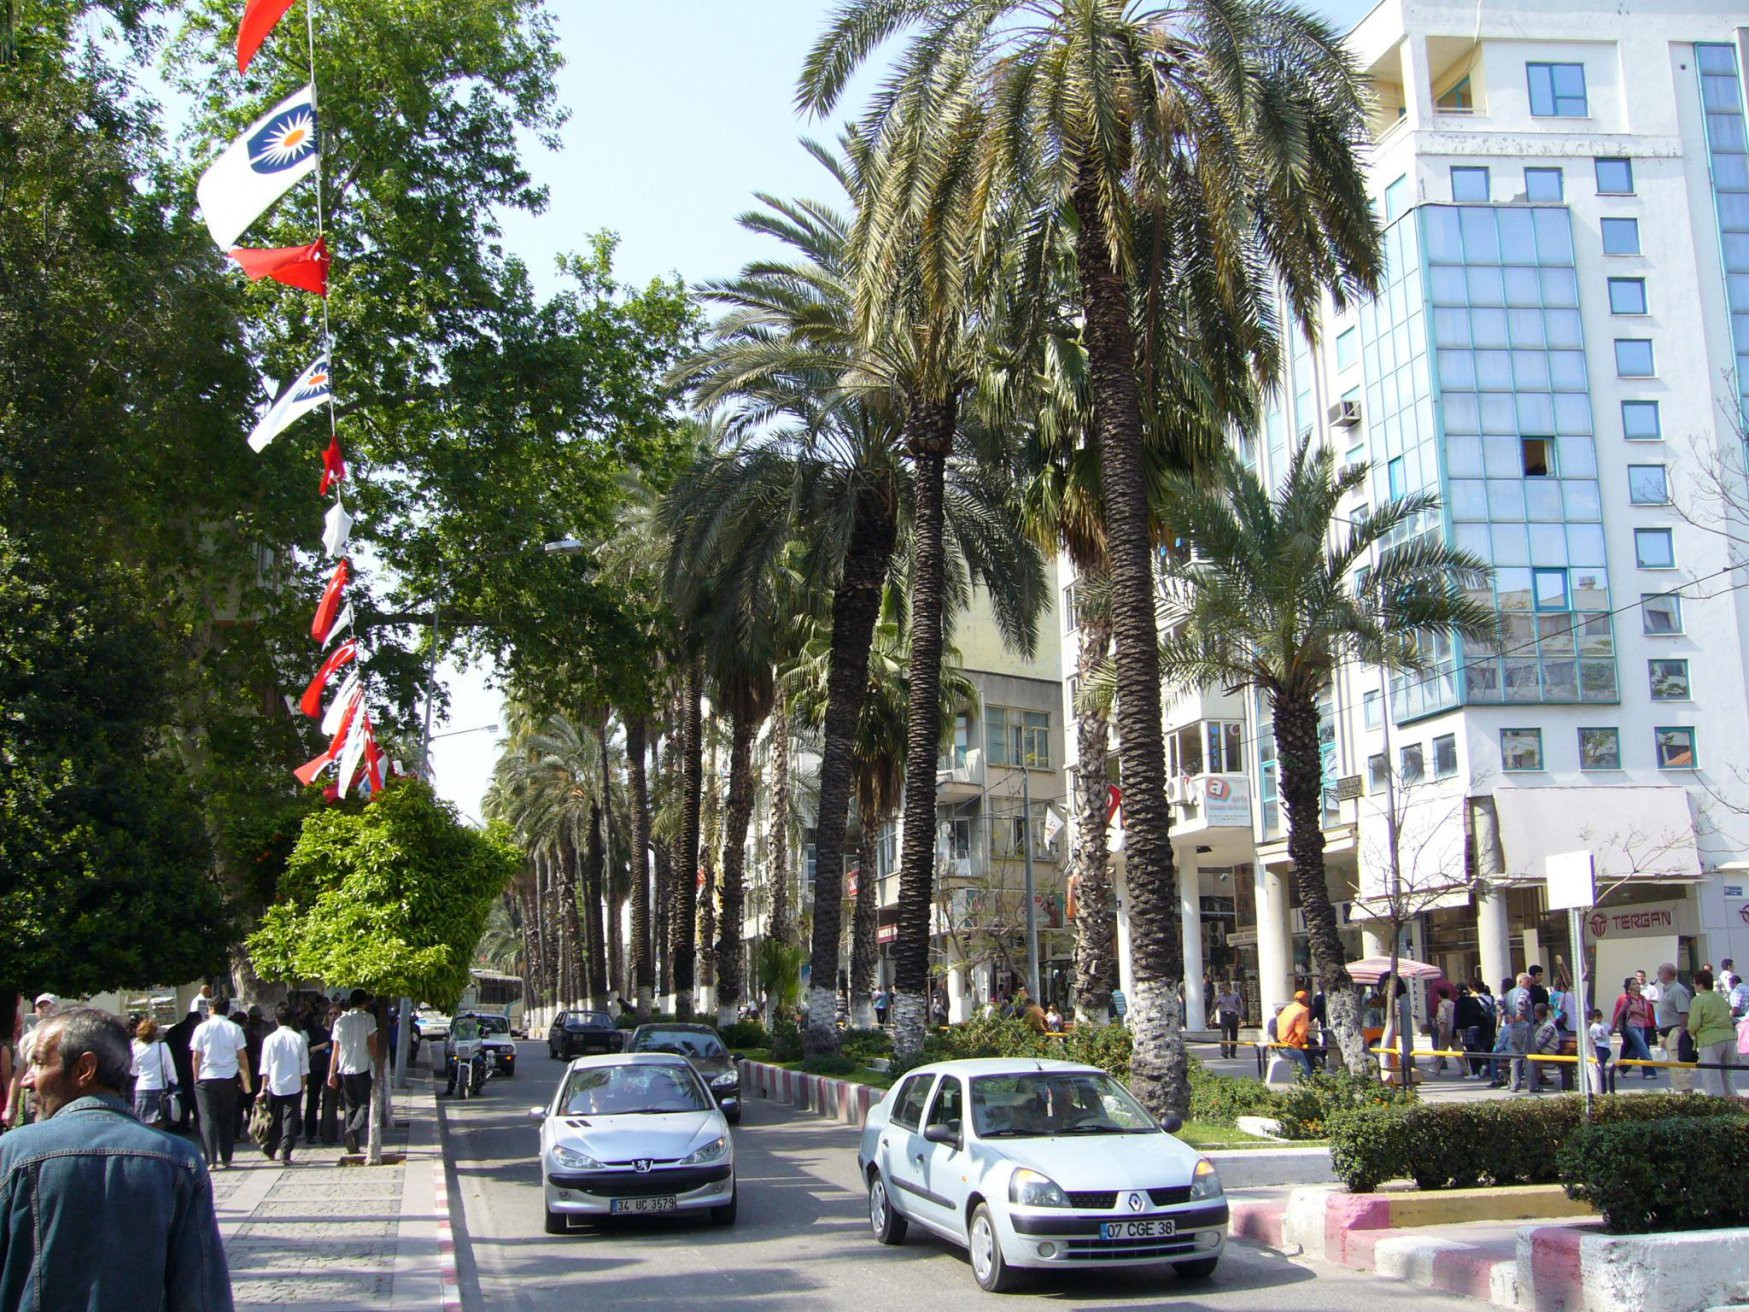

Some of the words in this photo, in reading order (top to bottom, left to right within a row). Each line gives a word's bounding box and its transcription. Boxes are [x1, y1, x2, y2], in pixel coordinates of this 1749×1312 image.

[1611, 911, 1672, 931] TERGAN
[617, 1200, 629, 1211] 34
[636, 1199, 647, 1210] UC
[651, 1198, 675, 1209] 3579
[1107, 1224, 1122, 1238] 07
[1127, 1223, 1154, 1237] CGE
[1158, 1221, 1173, 1235] 38
